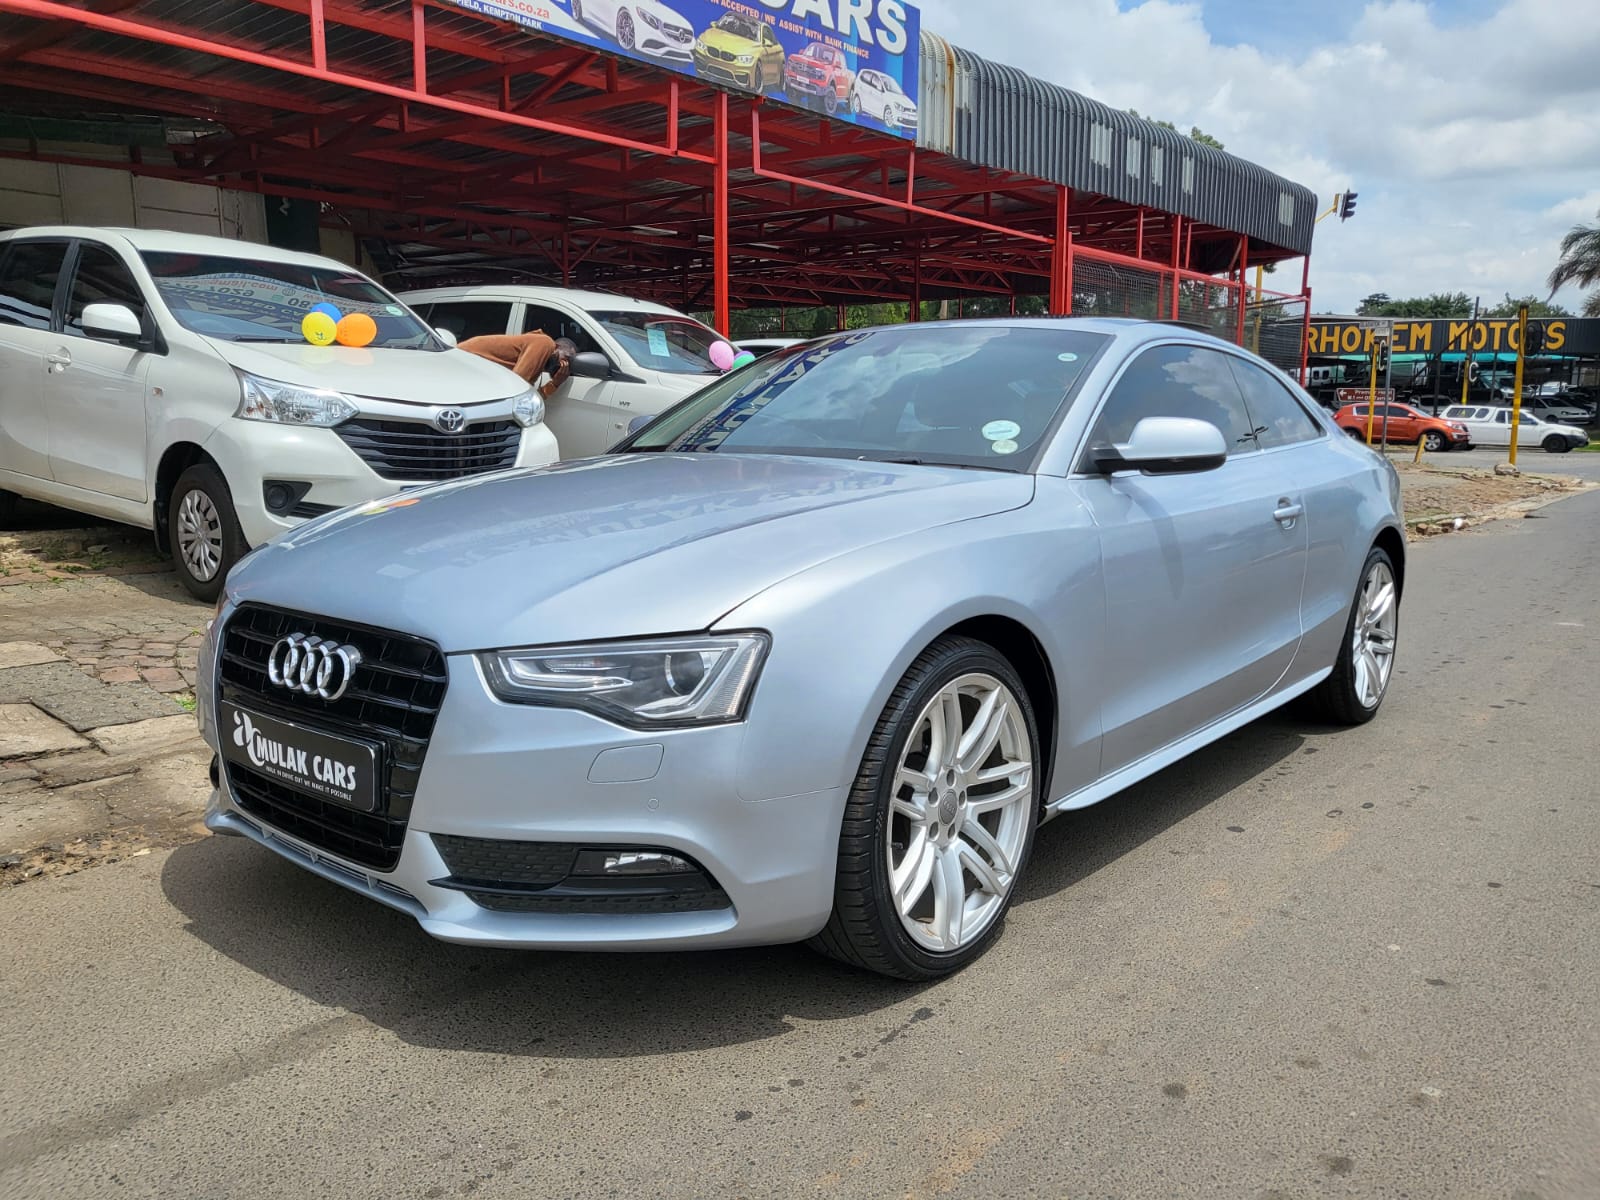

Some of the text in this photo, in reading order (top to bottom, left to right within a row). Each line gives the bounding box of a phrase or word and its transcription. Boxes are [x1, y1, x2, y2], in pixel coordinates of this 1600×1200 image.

[483, 4, 520, 23] KEMPTON
[522, 16, 542, 30] PARK
[721, 0, 759, 19] ACCEPTED
[764, 13, 776, 25] WE
[778, 19, 804, 36] ASSIST
[804, 28, 822, 41] WITH
[824, 35, 842, 49] BANK
[843, 42, 870, 59] FINANCE
[757, 0, 907, 54] ARS
[1448, 322, 1566, 351] MOTOS
[256, 735, 308, 776] MULAK
[313, 755, 356, 791] CARS
[330, 788, 352, 802] POSSIBLE
